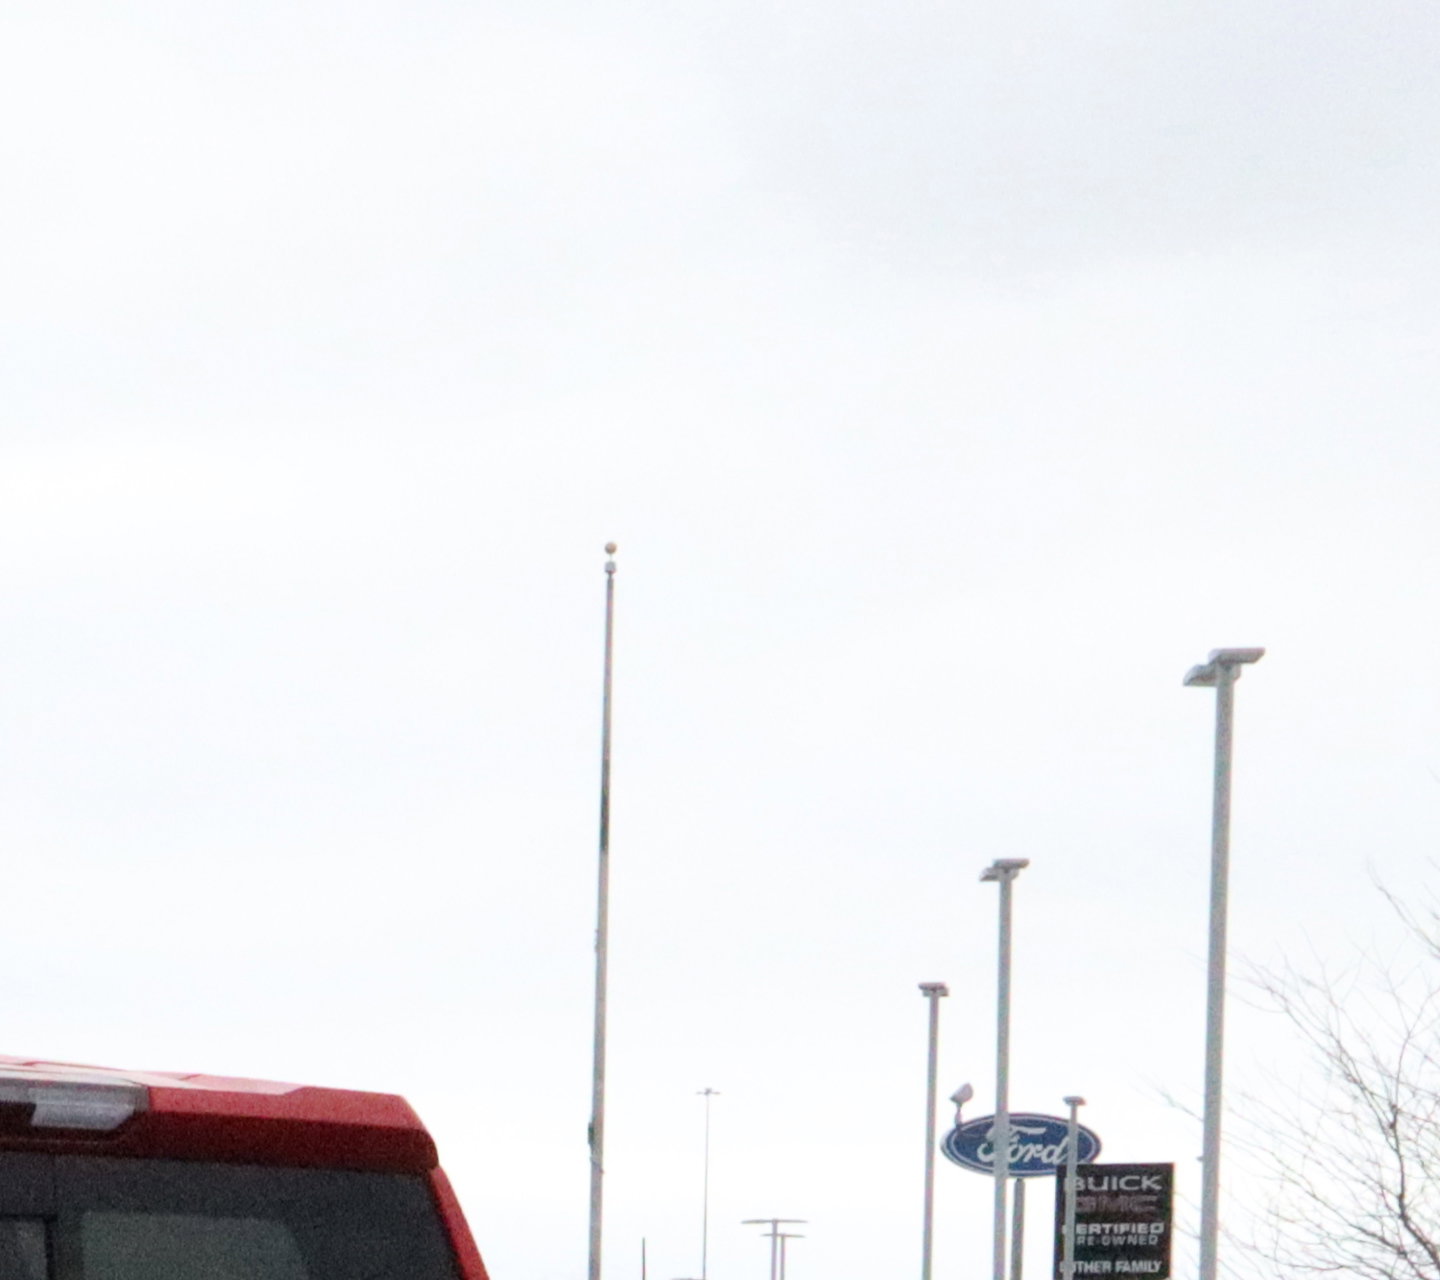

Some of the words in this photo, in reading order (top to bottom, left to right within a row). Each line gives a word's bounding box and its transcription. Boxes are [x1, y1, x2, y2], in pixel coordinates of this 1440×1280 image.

[977, 1124, 1069, 1165] Ford
[1062, 1222, 1165, 1235] ERTIFIED
[1075, 1234, 1159, 1246] RE-OWNED
[1059, 1260, 1112, 1273] THER
[1115, 1260, 1162, 1273] FAMILY
